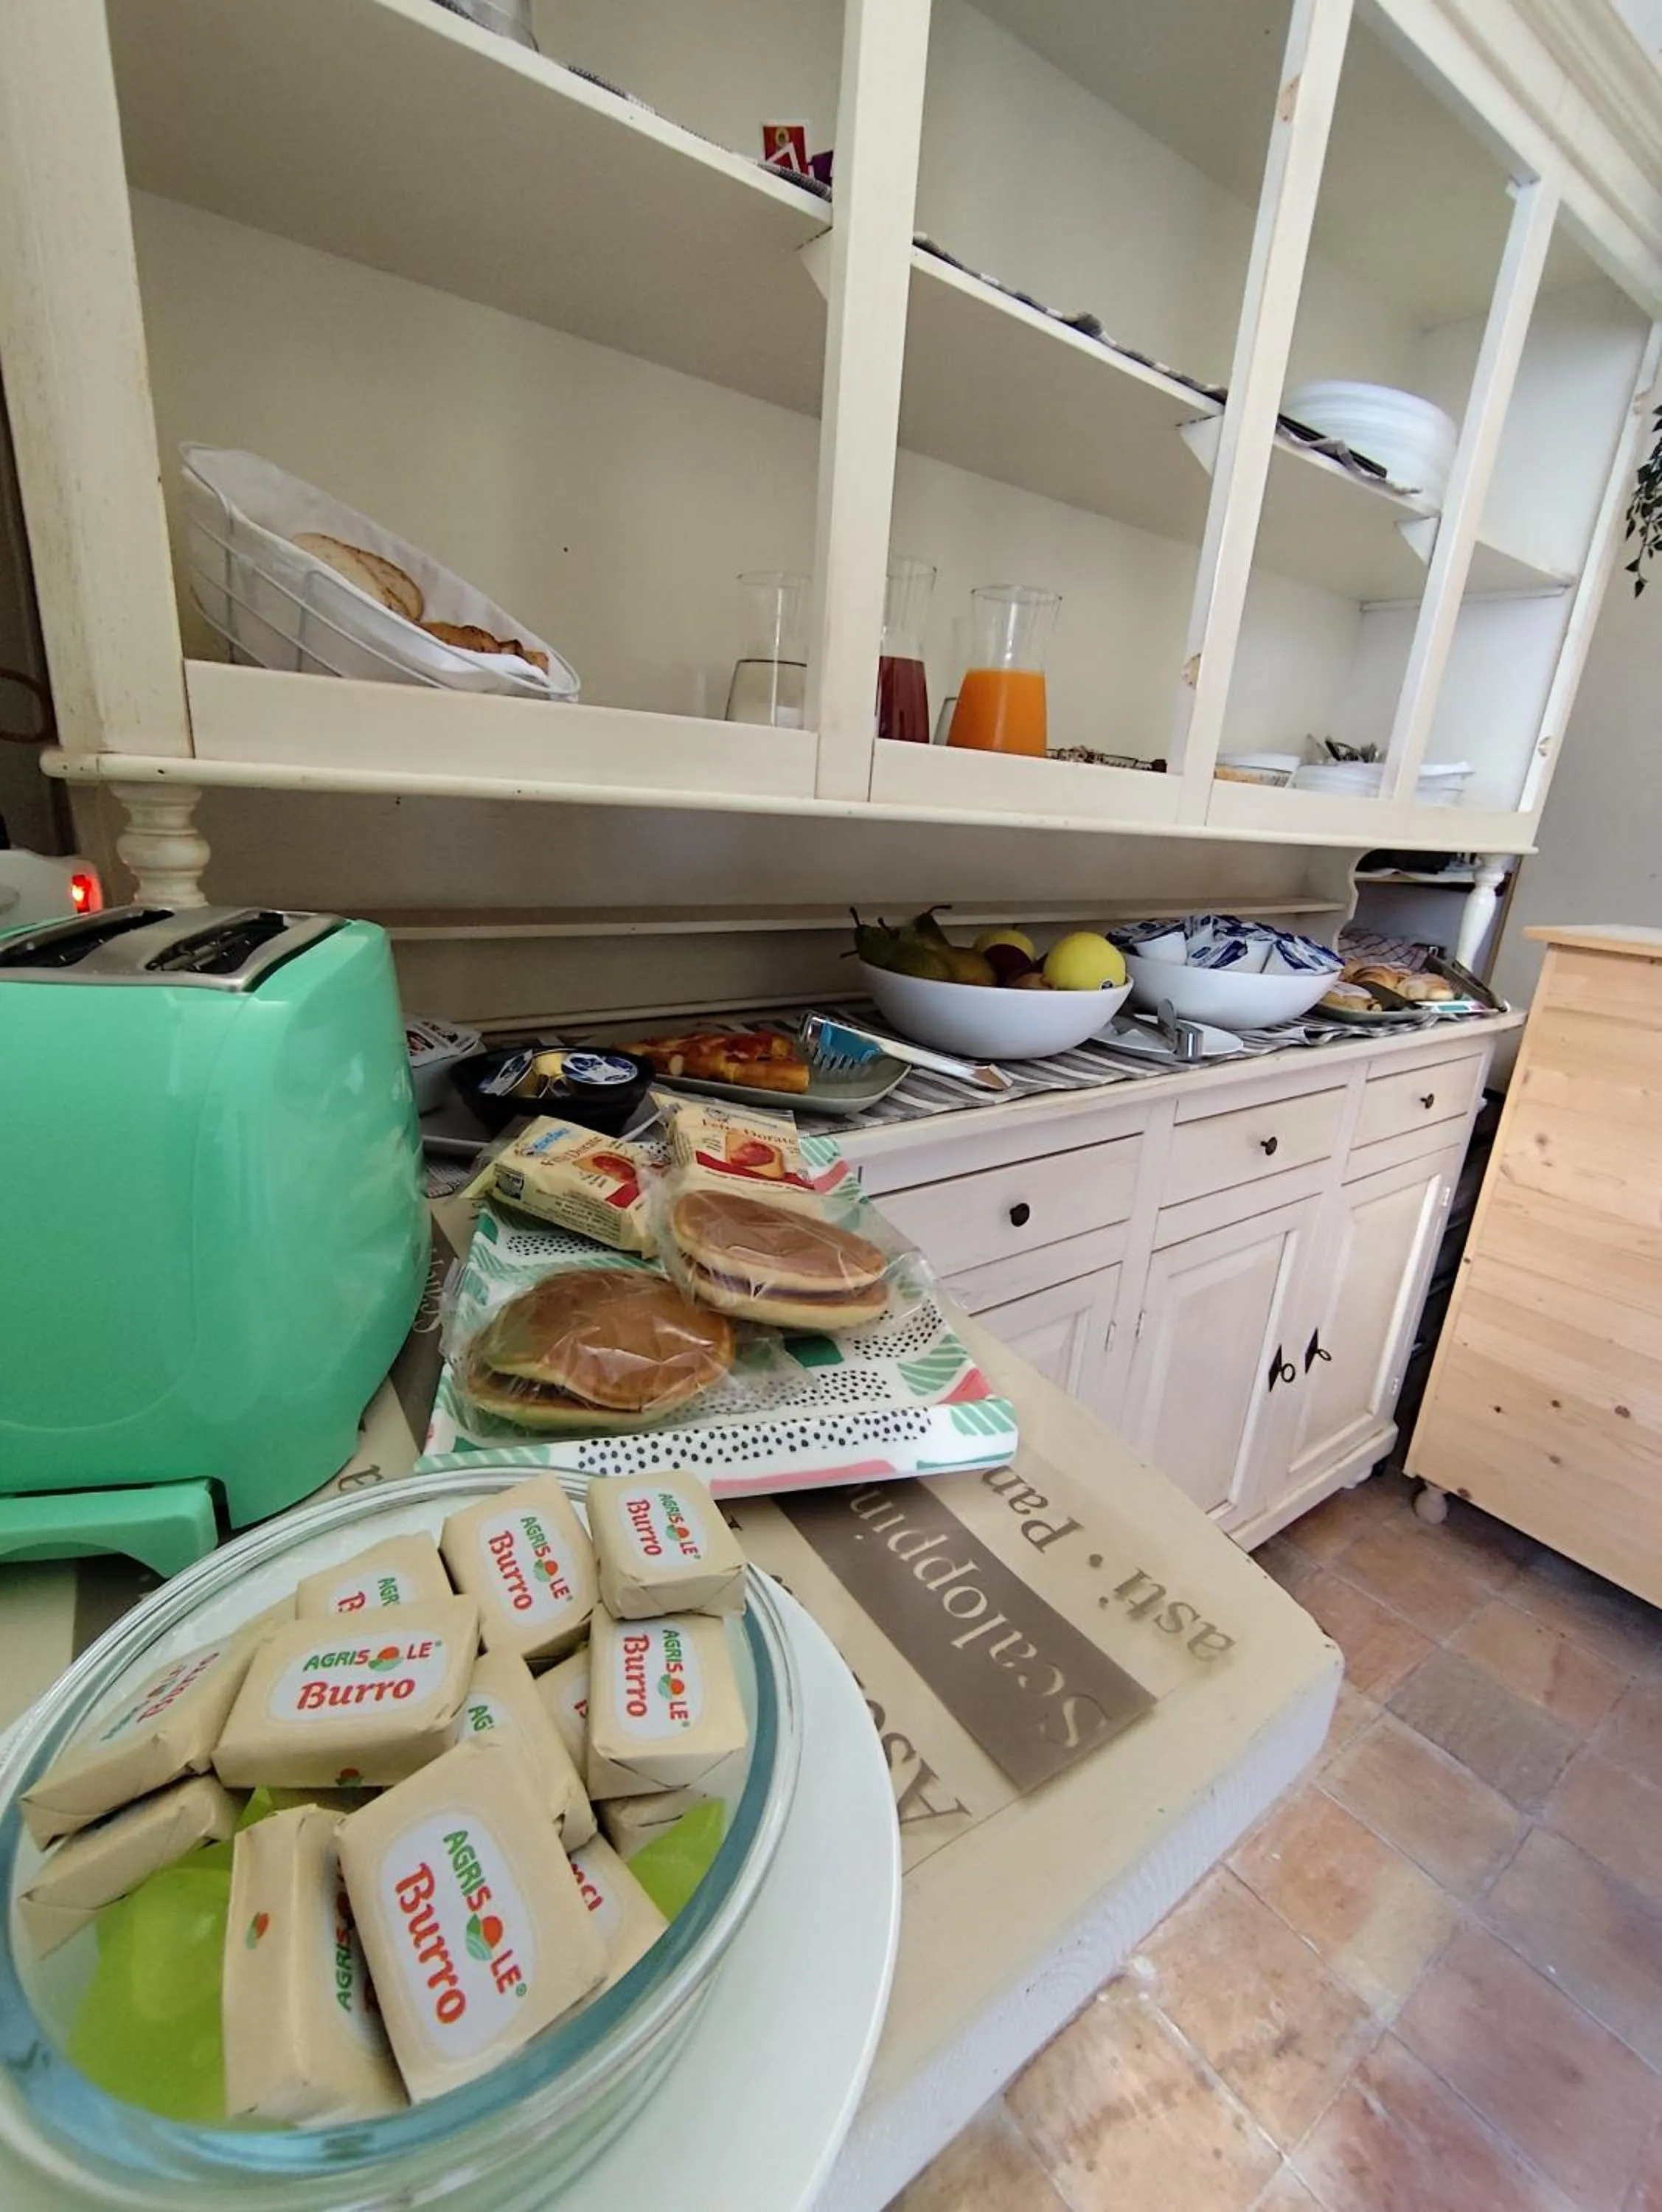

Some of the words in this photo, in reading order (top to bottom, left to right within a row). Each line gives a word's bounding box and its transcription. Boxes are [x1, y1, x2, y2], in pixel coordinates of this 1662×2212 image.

[625, 1498, 662, 1557] Burro
[981, 1465, 1084, 1553] Pan
[488, 1529, 533, 1611] Burro
[849, 1482, 1113, 1747] Scaloppin
[296, 1678, 416, 1711] Burro
[623, 1634, 650, 1718] Burro
[335, 1892, 354, 2008] AGRIS
[395, 1862, 467, 2025] Burro
